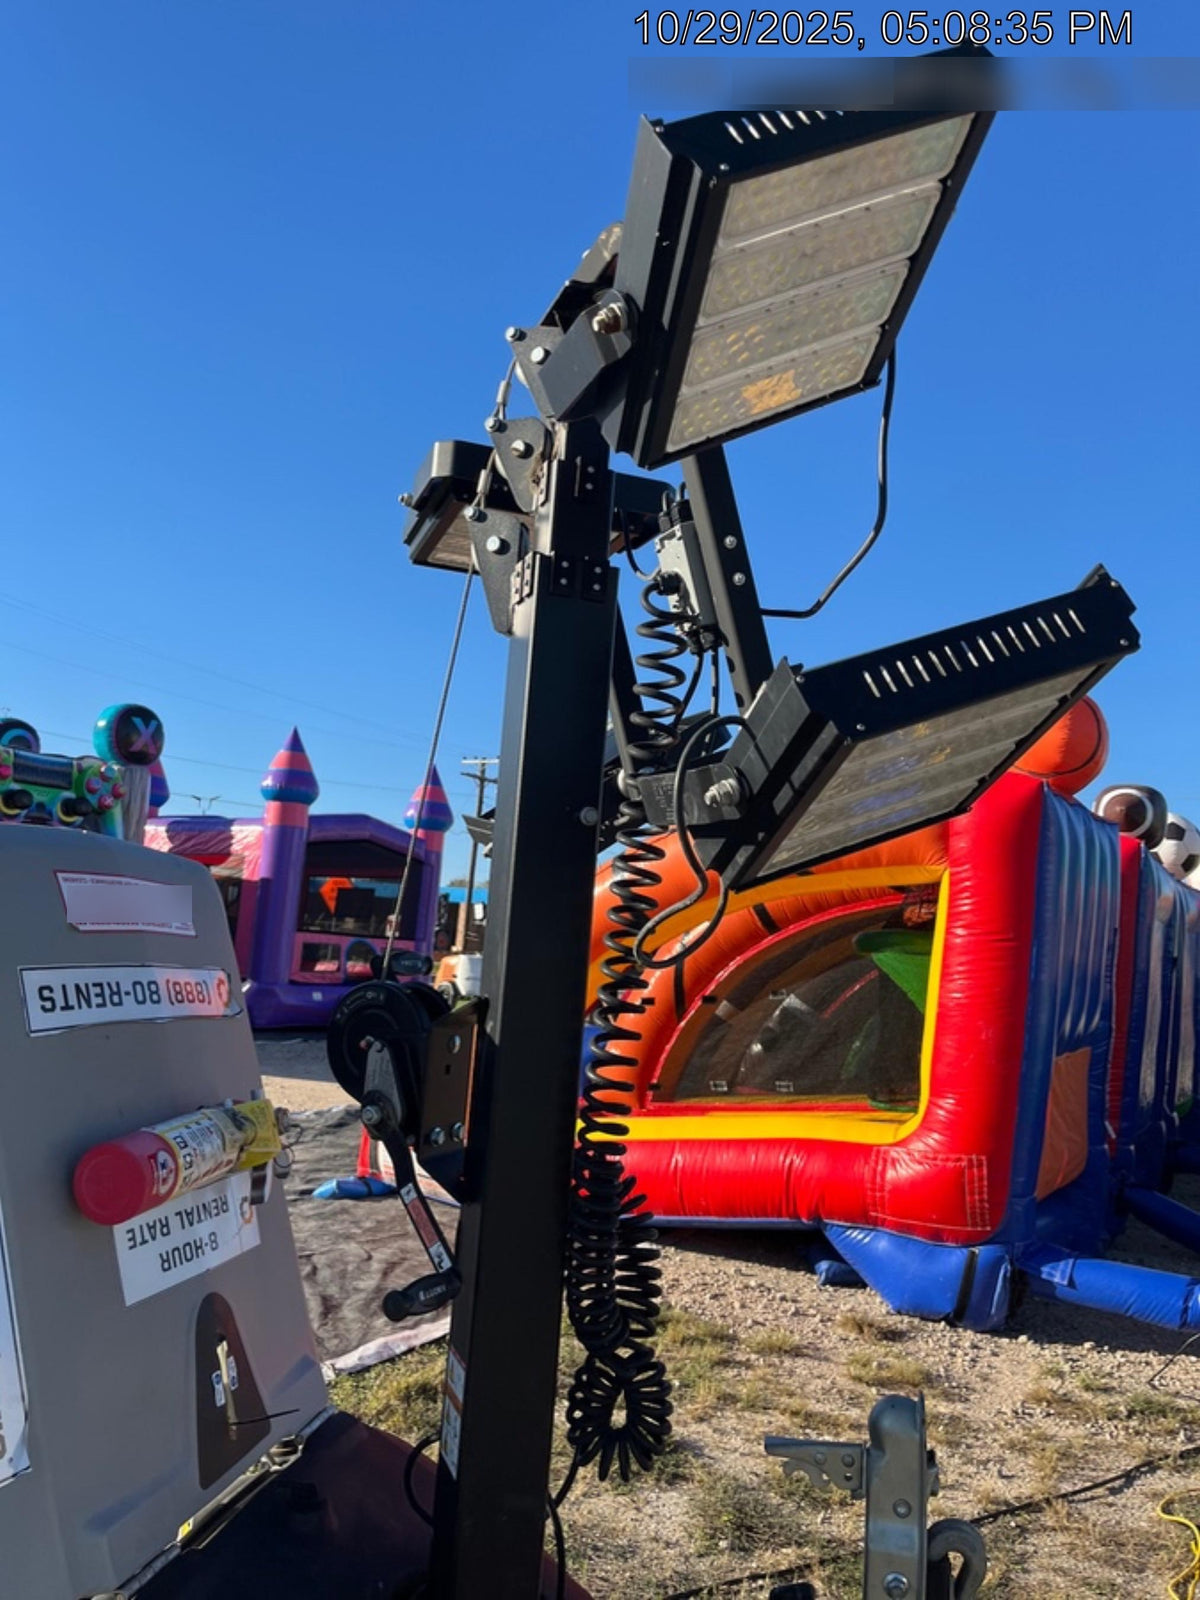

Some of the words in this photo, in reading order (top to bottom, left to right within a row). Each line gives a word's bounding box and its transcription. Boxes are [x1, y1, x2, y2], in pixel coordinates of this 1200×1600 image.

[38, 979, 162, 1014] 80-RENTS
[165, 978, 213, 1007] (888)
[174, 1193, 230, 1230] RENTAL
[125, 1218, 171, 1251] RATE
[159, 1231, 219, 1273] 8-HOUR
